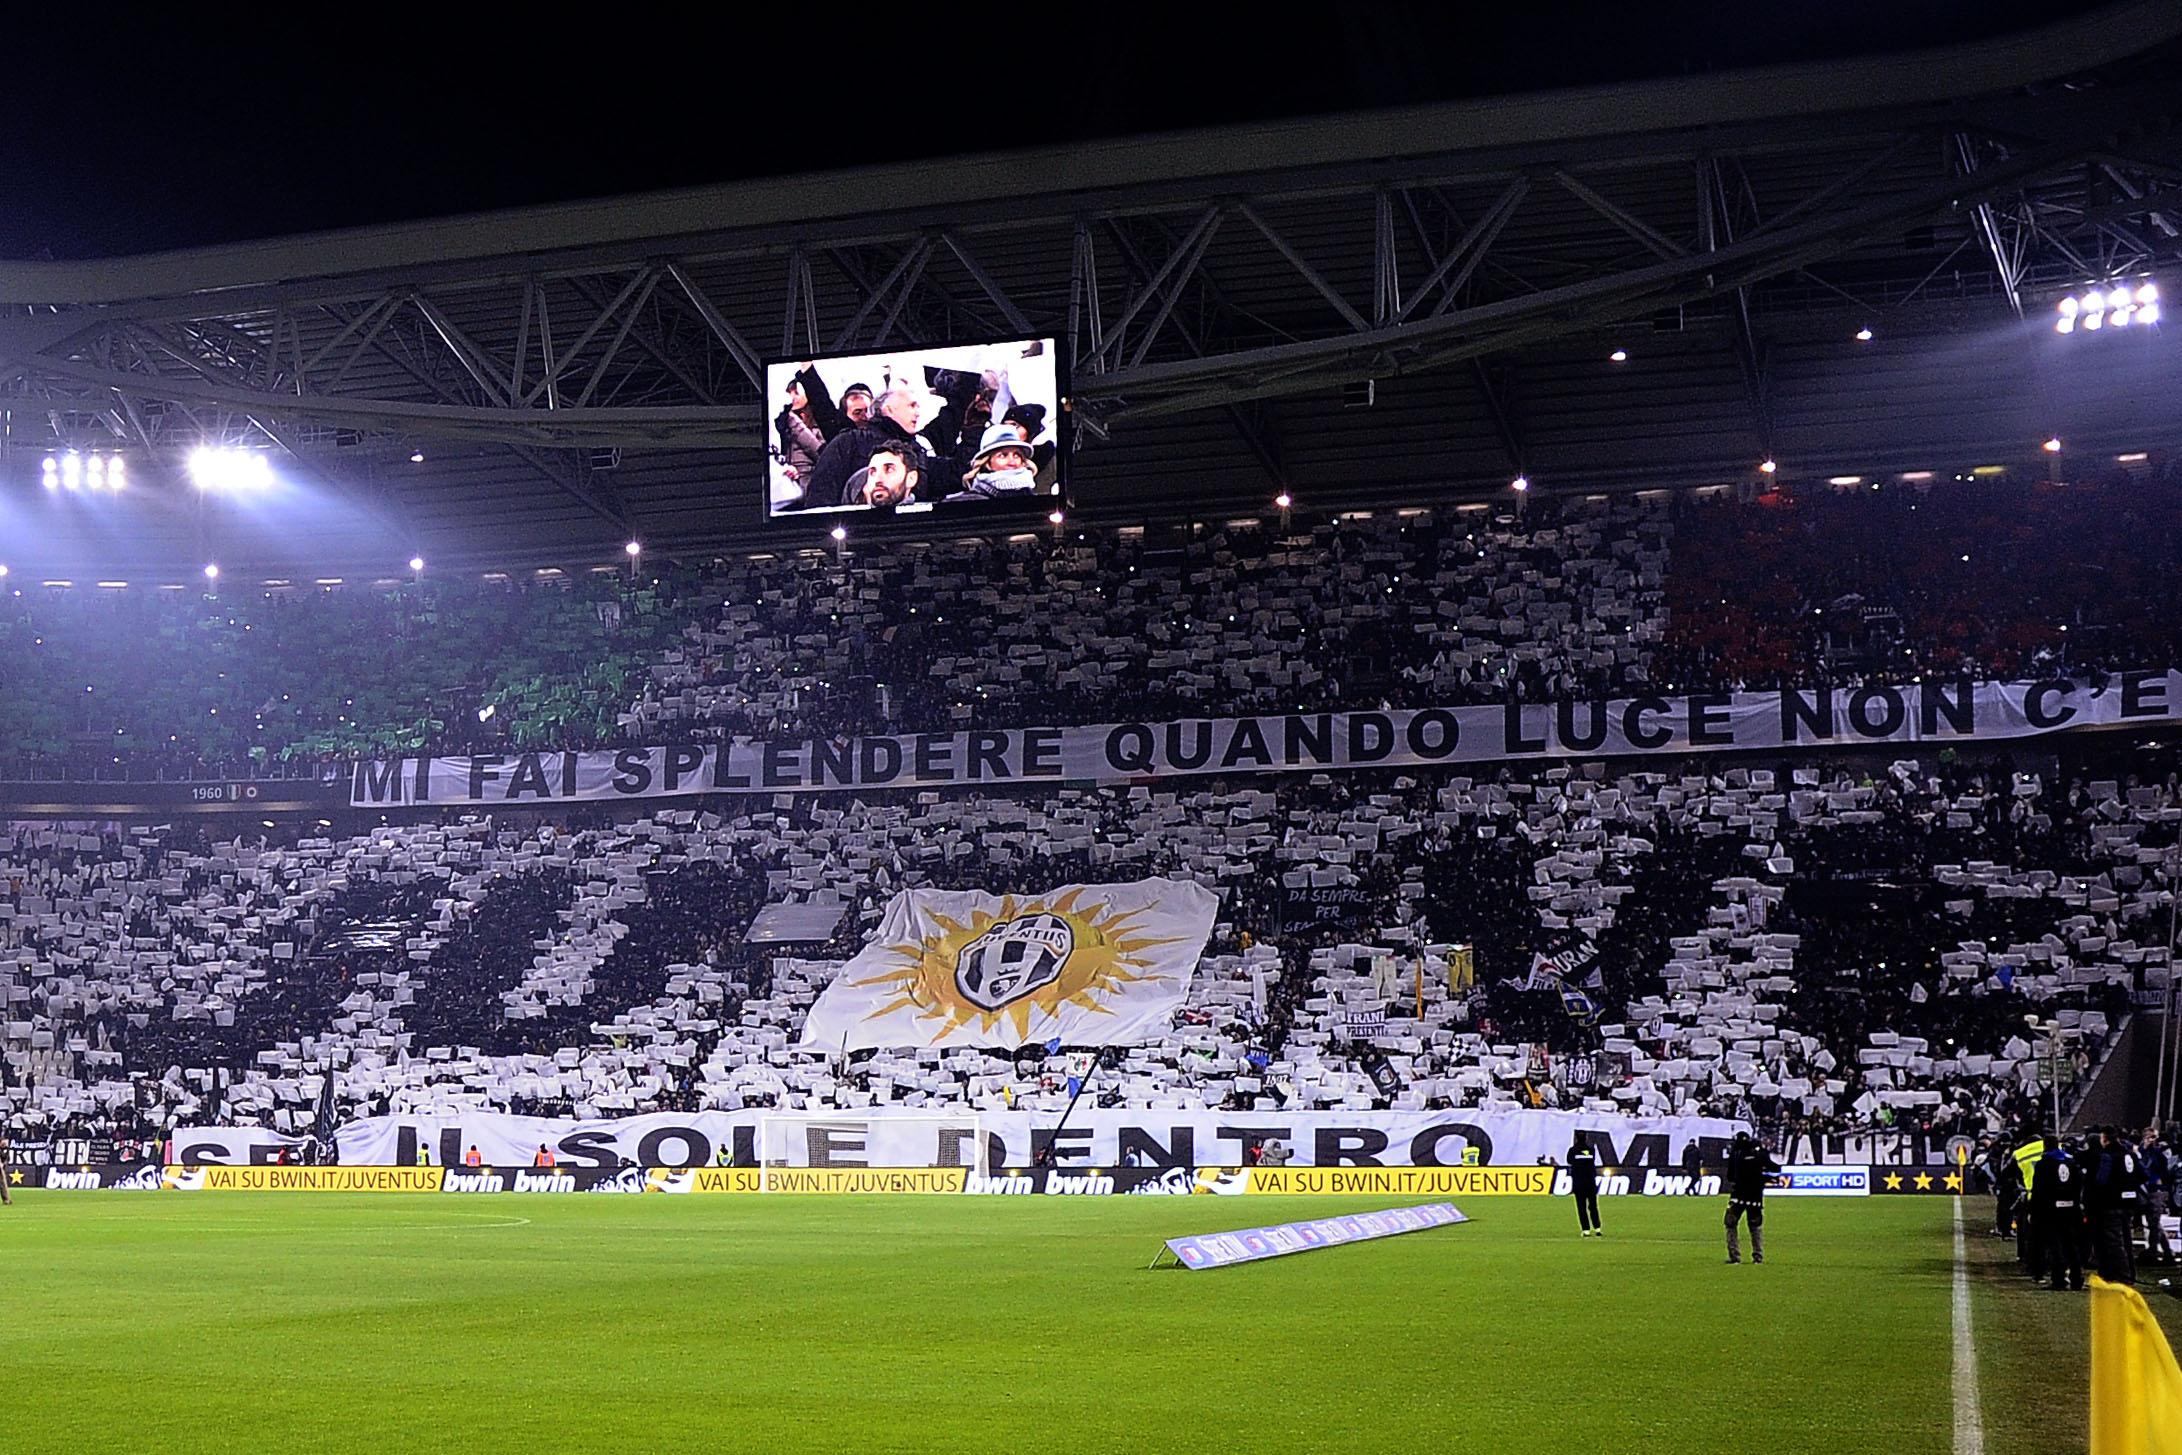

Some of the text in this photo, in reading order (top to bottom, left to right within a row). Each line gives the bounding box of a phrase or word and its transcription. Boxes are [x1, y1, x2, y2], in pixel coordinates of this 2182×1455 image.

[353, 758, 430, 802] MI
[468, 752, 577, 799] FAI
[612, 729, 1063, 795] SPLENDERE
[1105, 709, 1460, 774] QUANDO
[1504, 695, 1734, 753] LUCE
[1780, 682, 1974, 741] NON
[192, 787, 222, 800] 1960
[1288, 889, 1368, 903] DA SEMPRE
[1315, 905, 1341, 918] PER
[397, 1126, 492, 1167] IL
[557, 1122, 869, 1168] SOLE
[936, 1123, 1493, 1167] DENTRO
[46, 1167, 101, 1190] bwin
[209, 1170, 437, 1190] VAI SU BWIN.IT/JUVENTUS
[443, 1169, 504, 1192] bwin
[513, 1169, 576, 1192] bwin
[698, 1172, 958, 1193] VAI SU BWIN.IT/JUVENTUS
[965, 1171, 1034, 1195] bwin
[1045, 1169, 1114, 1195] bwin
[1254, 1172, 1545, 1194] VAI SU BWIN.IT/JUVENTUS
[1553, 1168, 1630, 1195] bin
[1793, 1175, 1840, 1187] SPORT
[1841, 1175, 1864, 1187] HD
